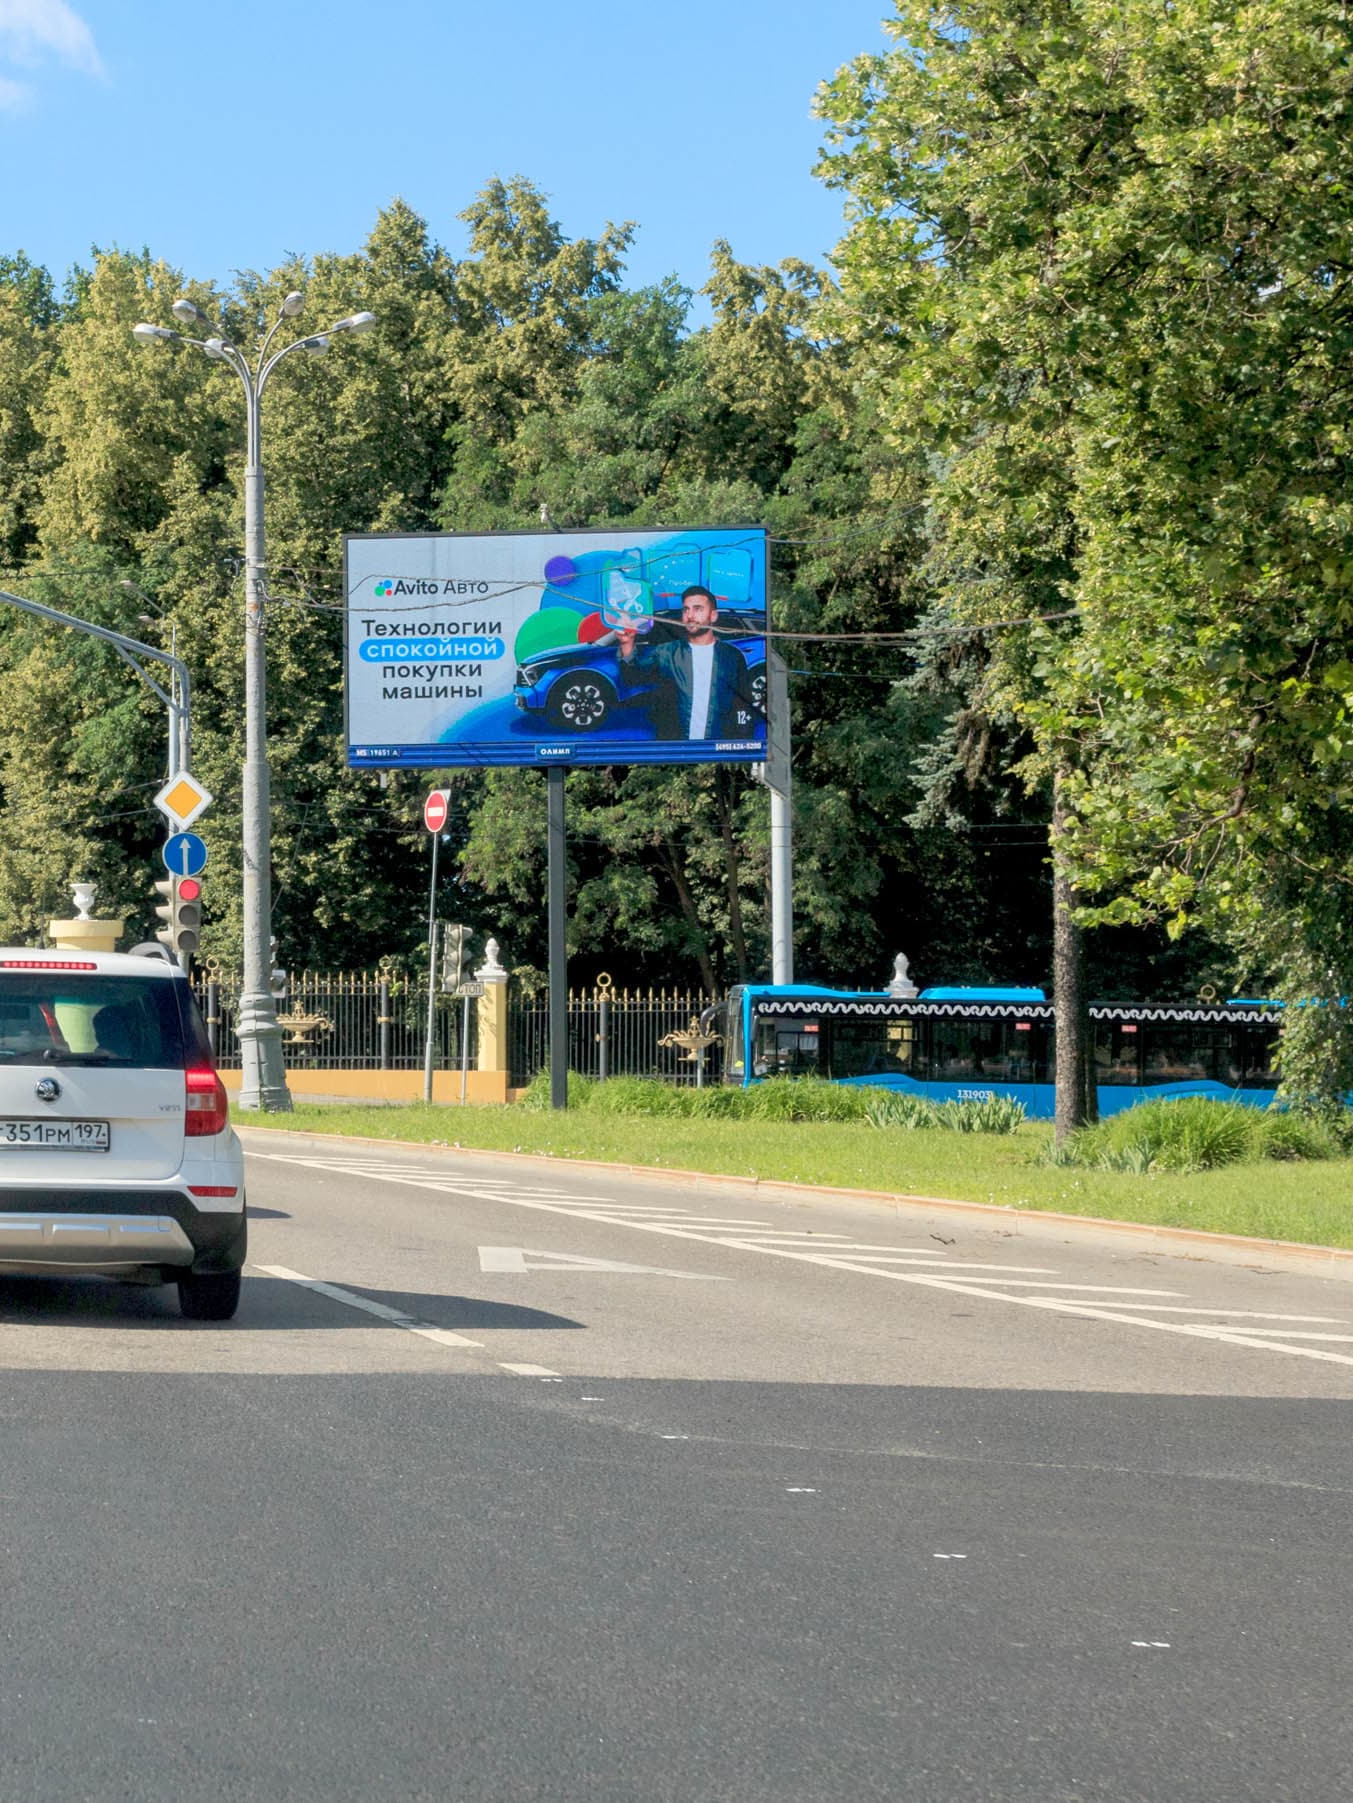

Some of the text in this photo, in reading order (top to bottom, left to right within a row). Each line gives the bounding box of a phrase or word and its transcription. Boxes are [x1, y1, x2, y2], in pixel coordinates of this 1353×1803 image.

[394, 579, 489, 595] Avito Авто
[361, 620, 502, 637] Технологии
[367, 637, 498, 658] спокойной
[383, 664, 482, 682] покупки
[383, 685, 483, 700] машины
[737, 711, 752, 725] 12+
[75, 1123, 103, 1139] 197
